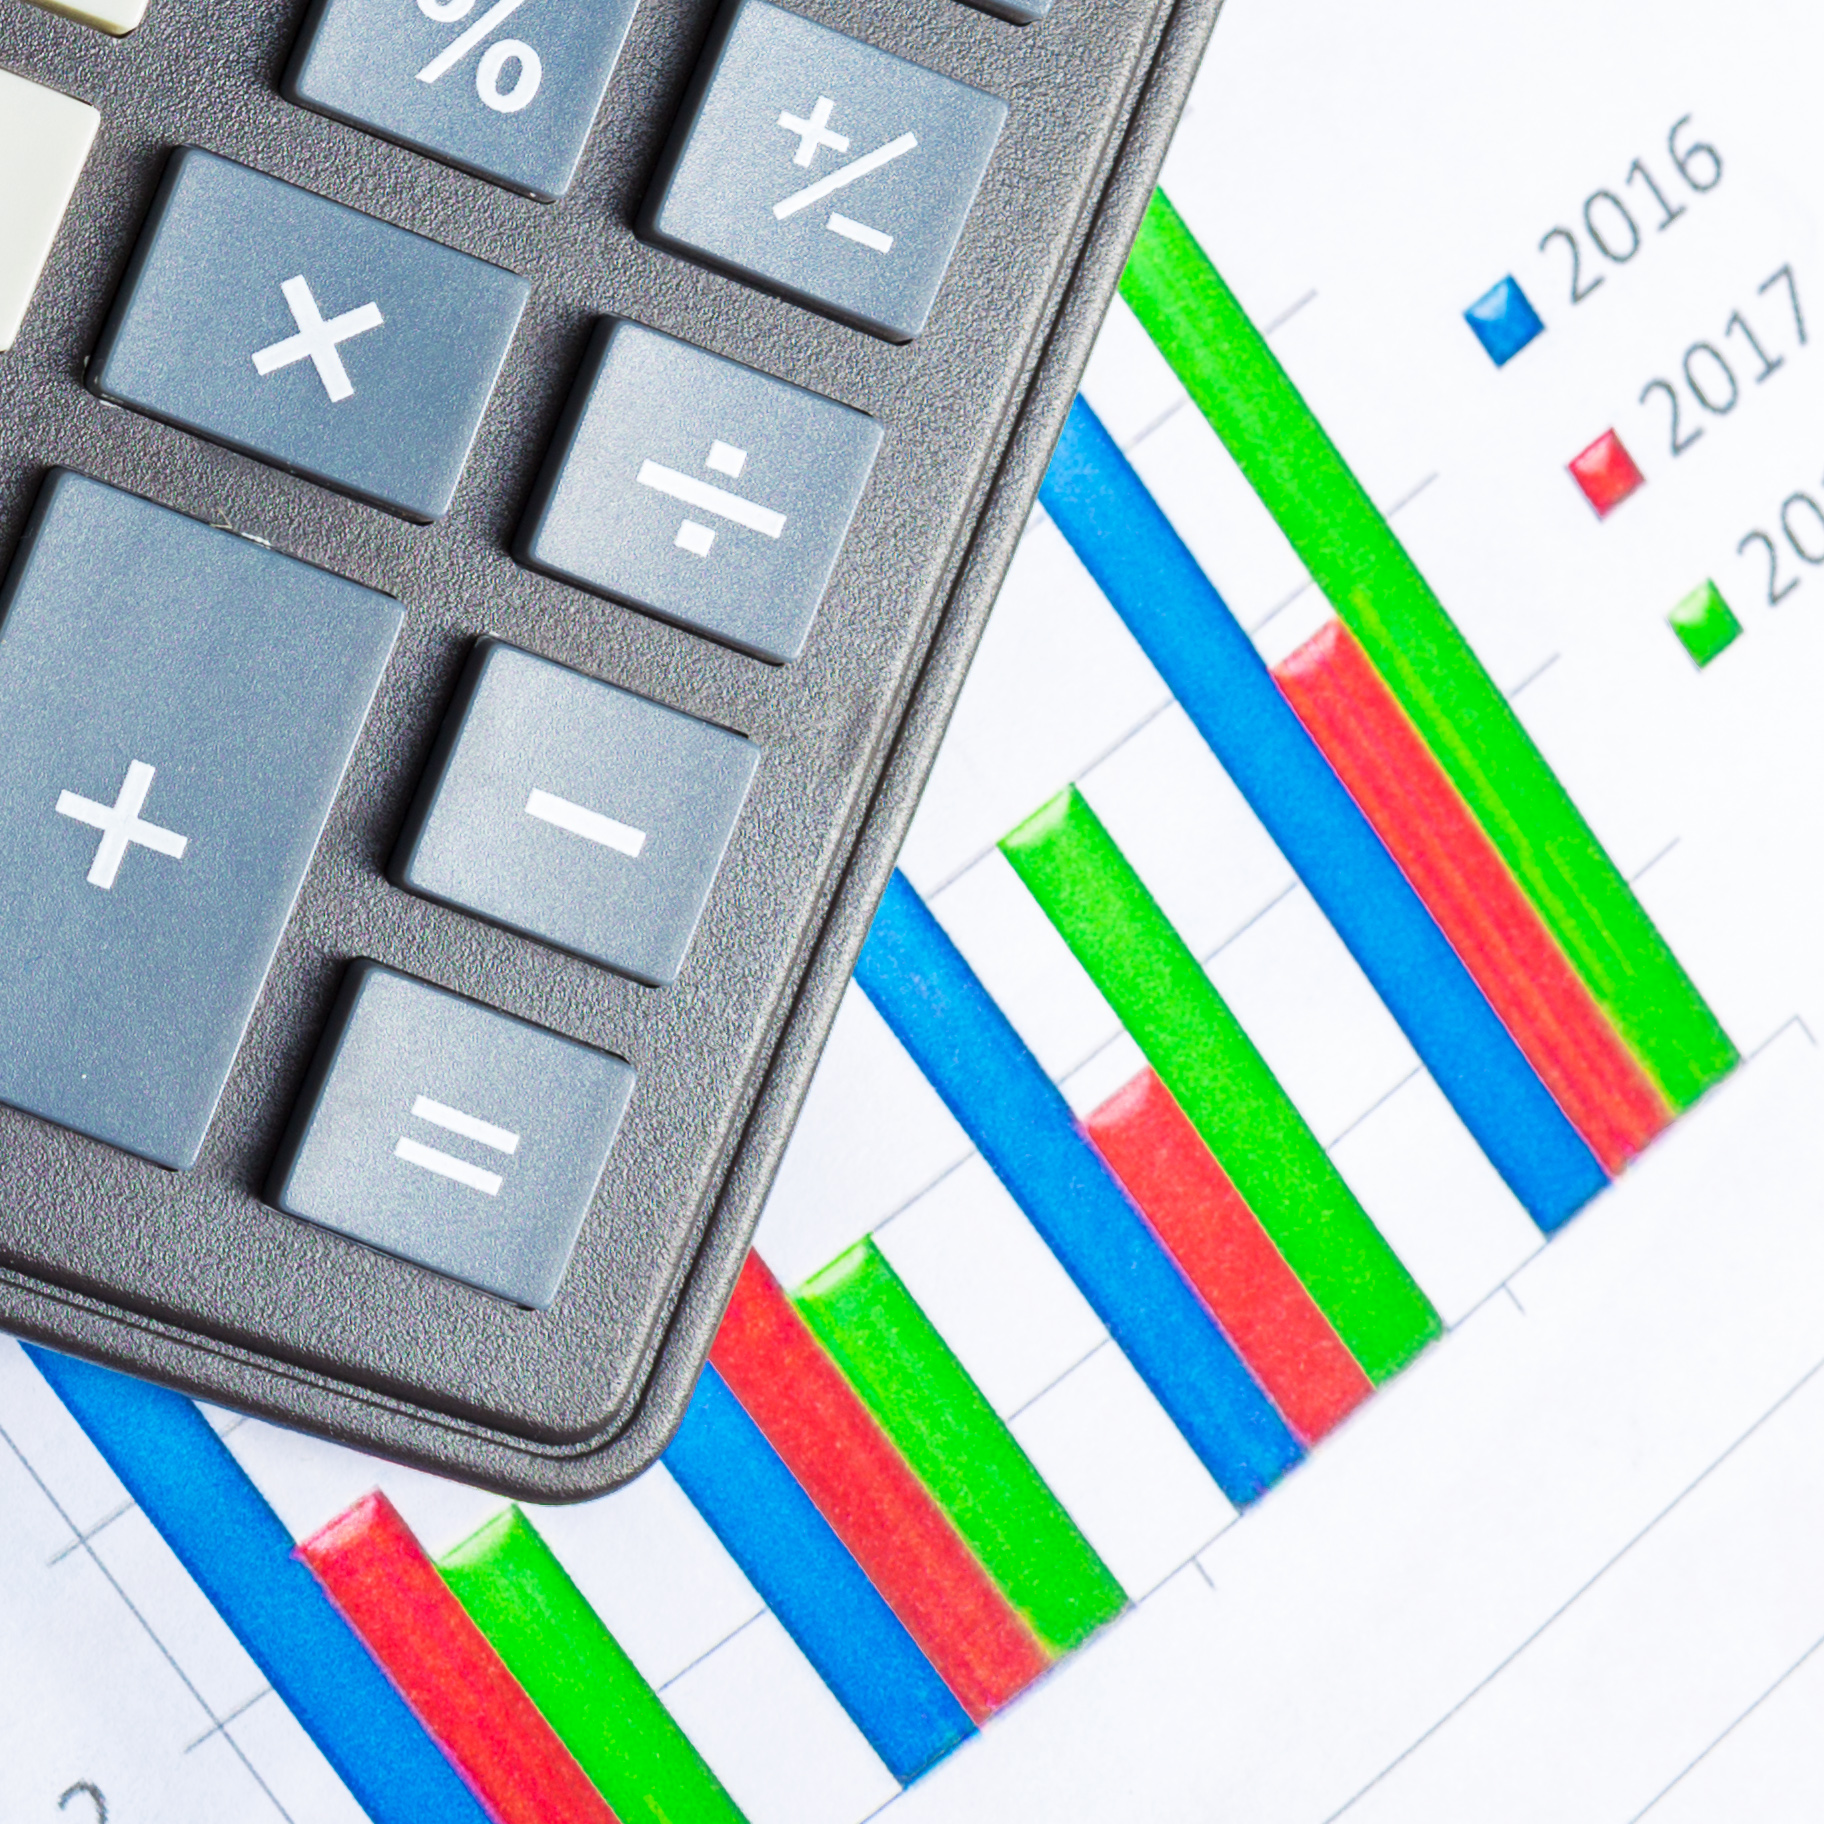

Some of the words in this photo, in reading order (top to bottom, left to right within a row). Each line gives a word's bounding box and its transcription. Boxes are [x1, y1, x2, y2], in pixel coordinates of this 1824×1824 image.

[1539, 115, 1723, 305] 2016
[1639, 264, 1807, 457] 2017
[1737, 492, 1824, 607] 20
